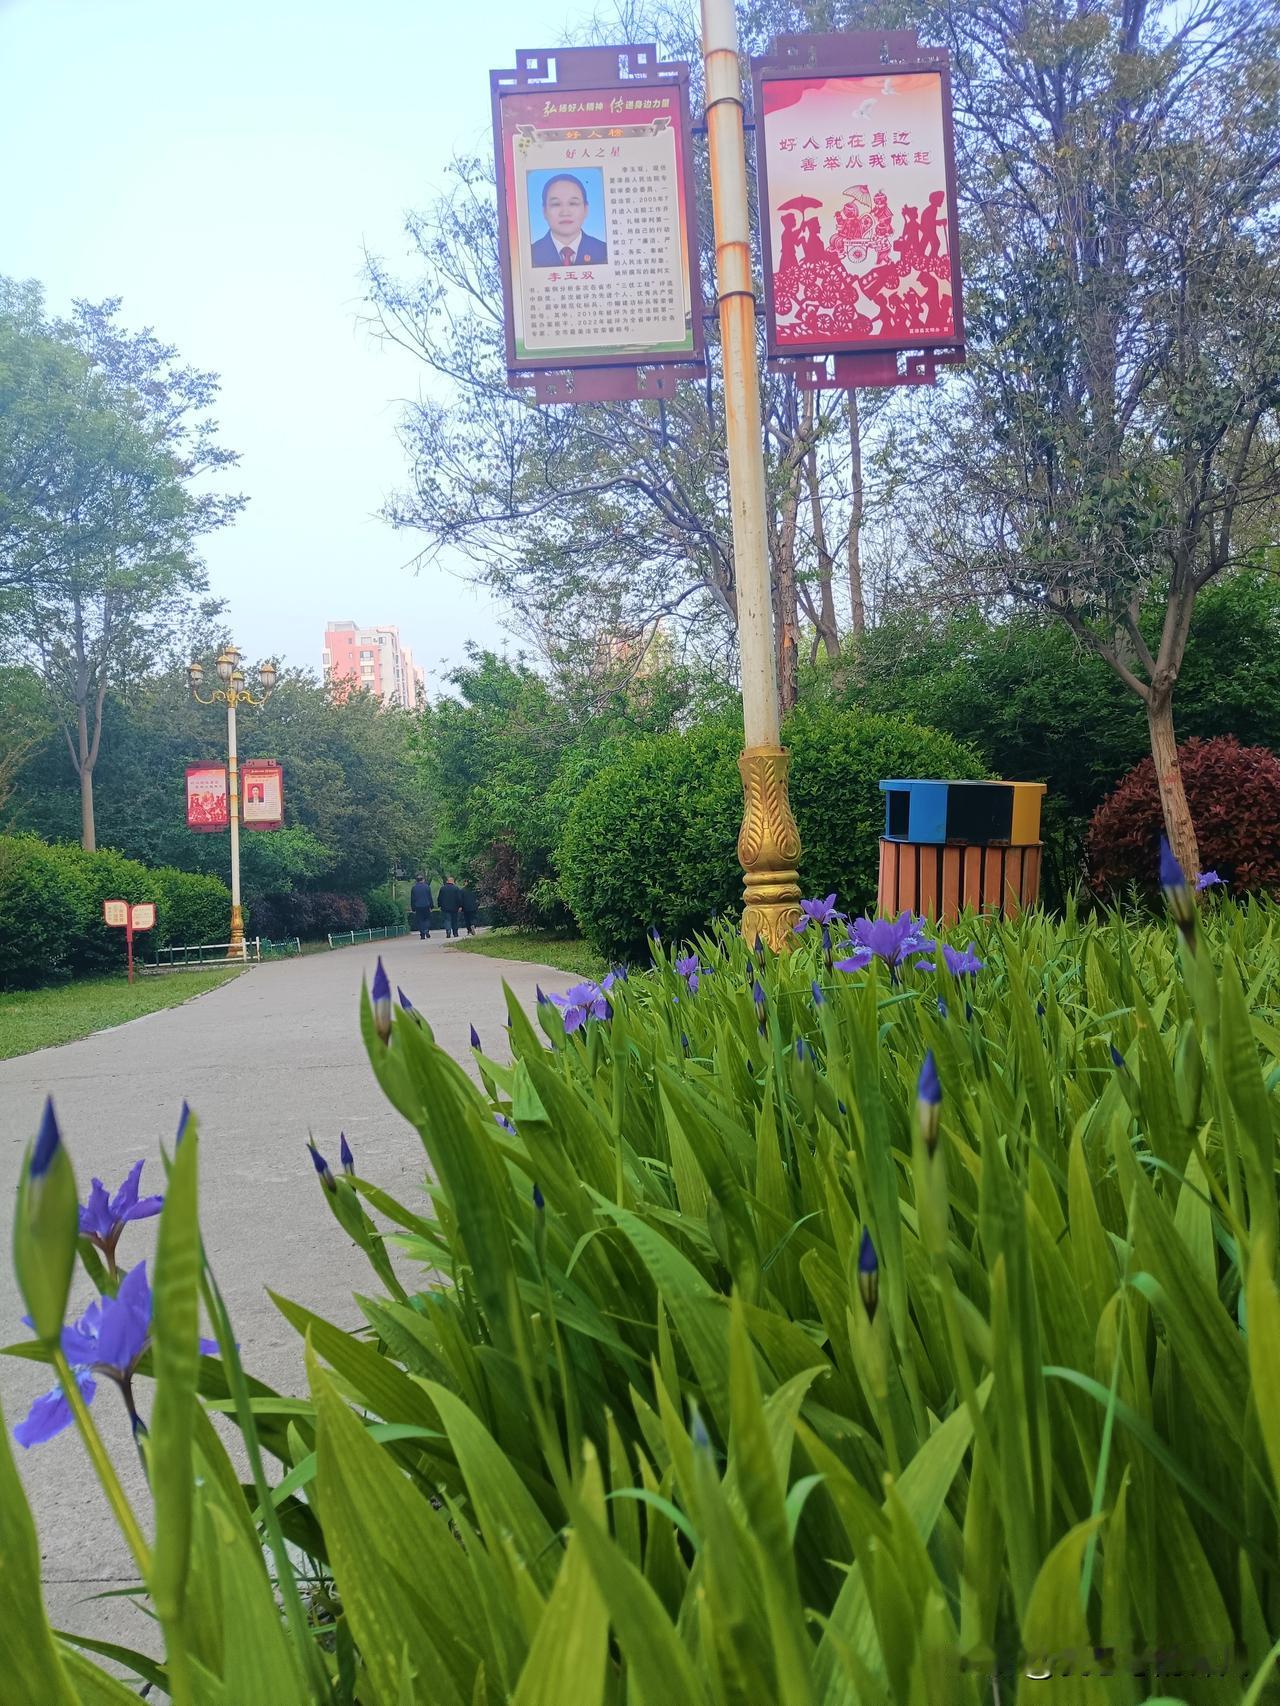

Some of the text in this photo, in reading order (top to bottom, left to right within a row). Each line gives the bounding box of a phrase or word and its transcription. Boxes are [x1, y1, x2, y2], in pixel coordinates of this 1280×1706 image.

[544, 96, 670, 117] 弘扬好人精神 传递身边力量
[779, 131, 911, 152] 好人就在身边
[566, 146, 621, 159] 好人之星
[801, 151, 932, 171] 善举从我做起
[547, 271, 594, 282] 李玉双
